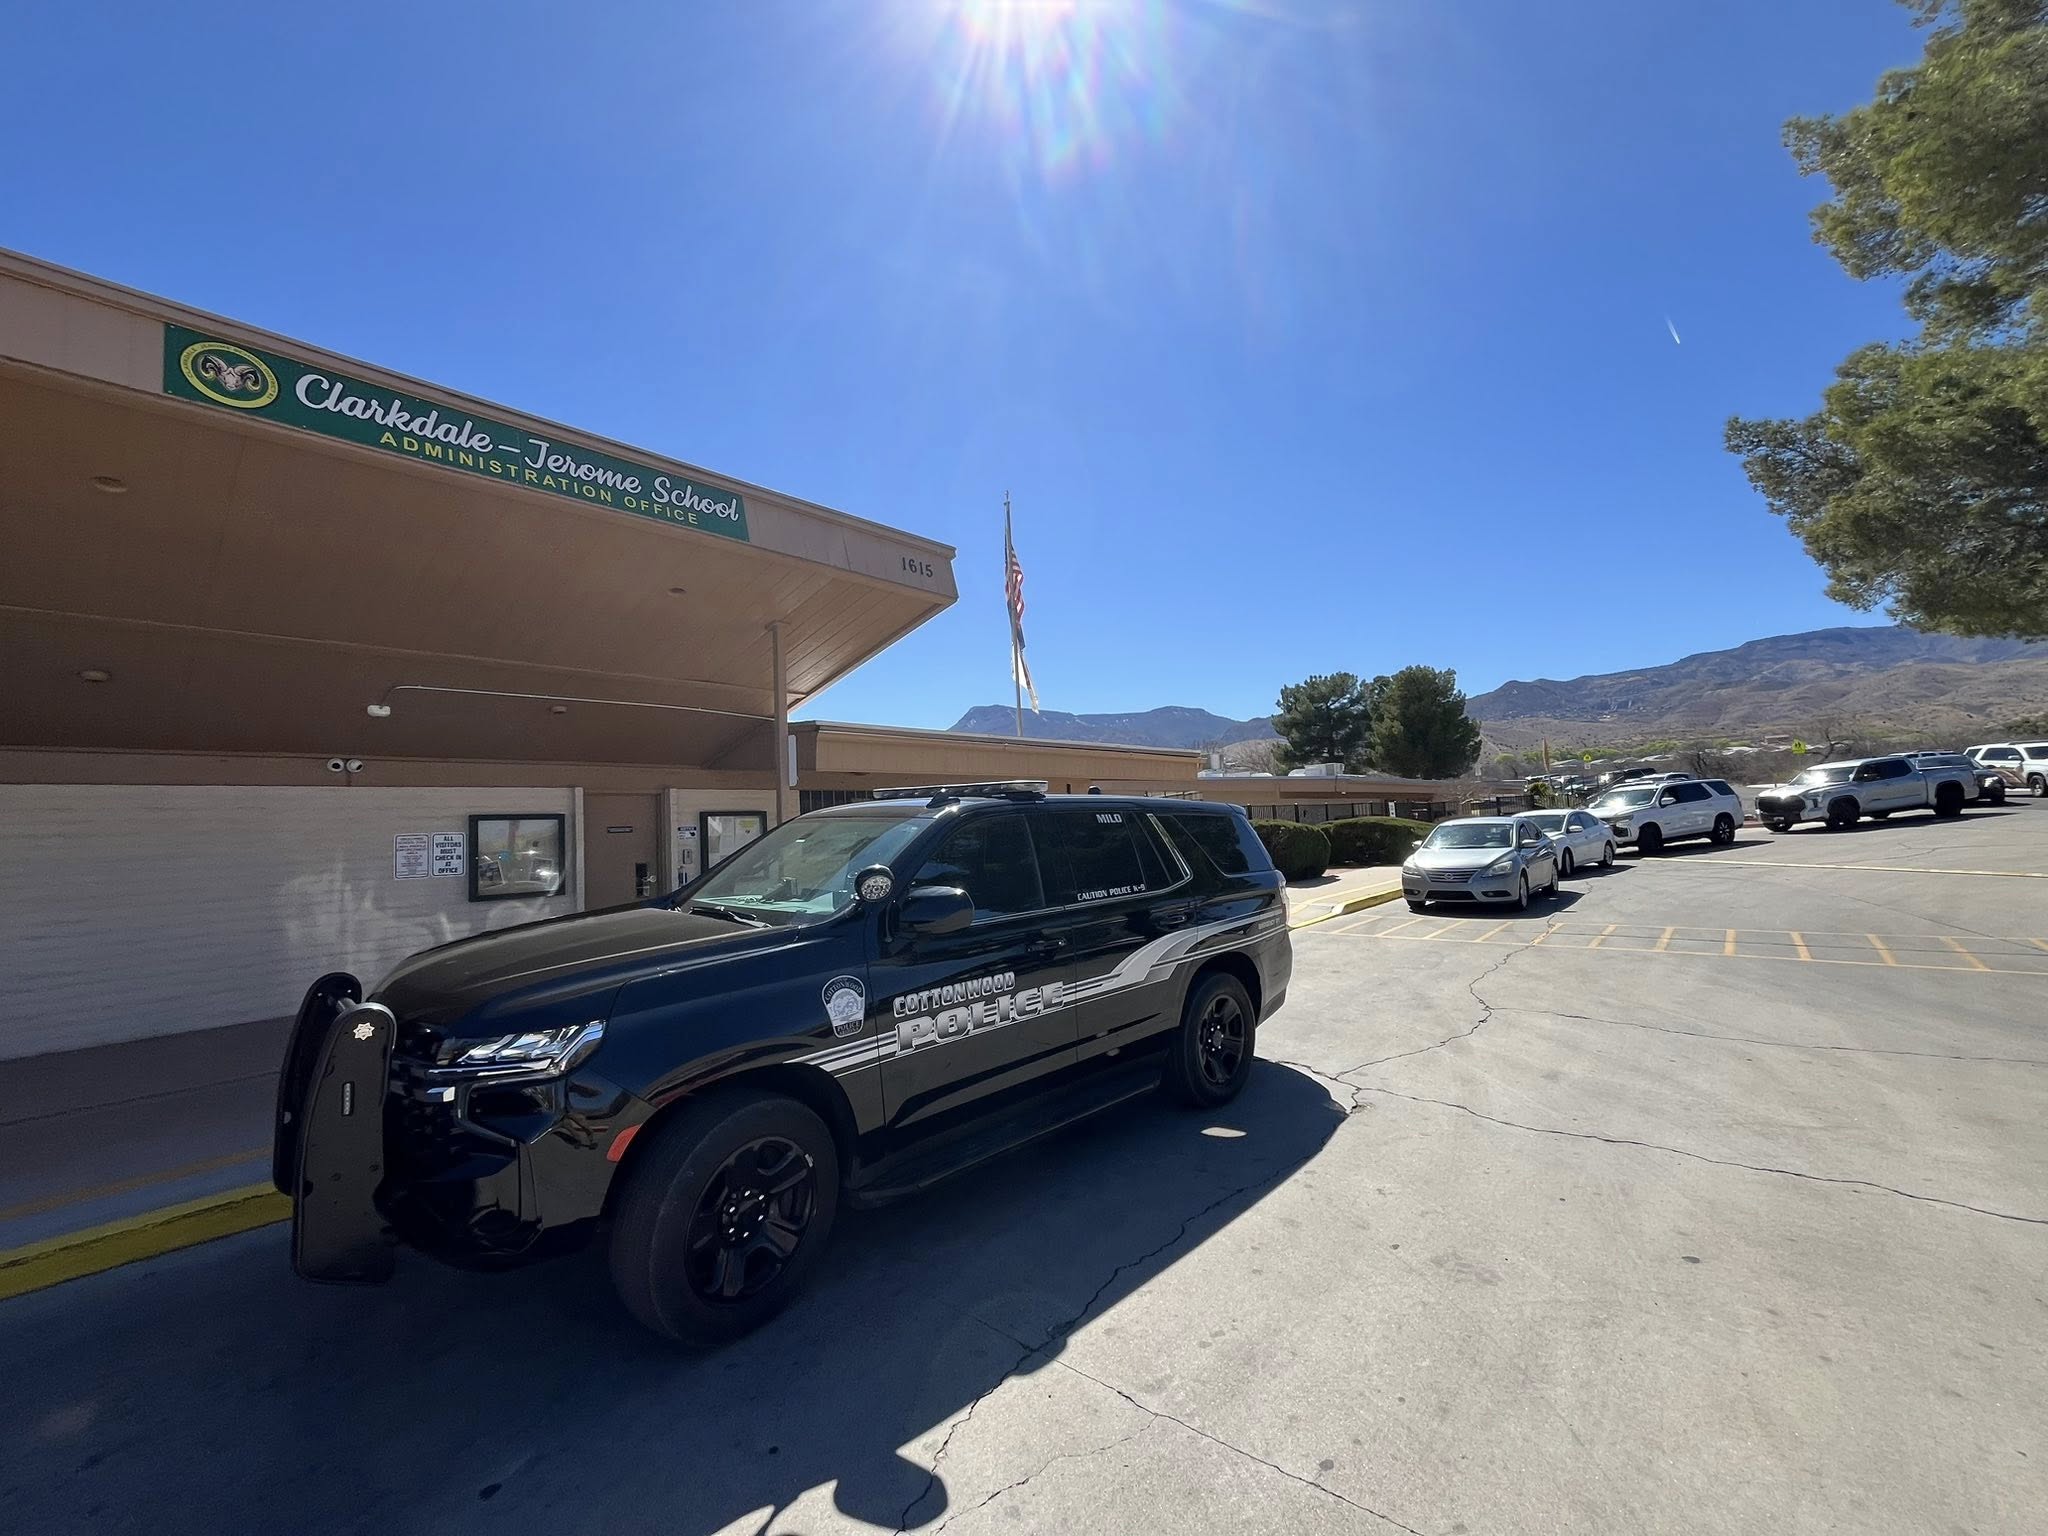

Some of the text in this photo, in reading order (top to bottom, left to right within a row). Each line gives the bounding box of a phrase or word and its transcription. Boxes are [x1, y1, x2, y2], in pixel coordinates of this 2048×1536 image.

[379, 432, 699, 525] ADMINISTRATION OFFICE
[651, 476, 739, 522] School
[902, 556, 933, 578] 1615
[1095, 813, 1123, 824] MILO
[1077, 883, 1146, 901] CAUTION POLICE K-9
[893, 971, 1016, 1018] COTTONWOOD
[894, 981, 1065, 1057] POLICE
